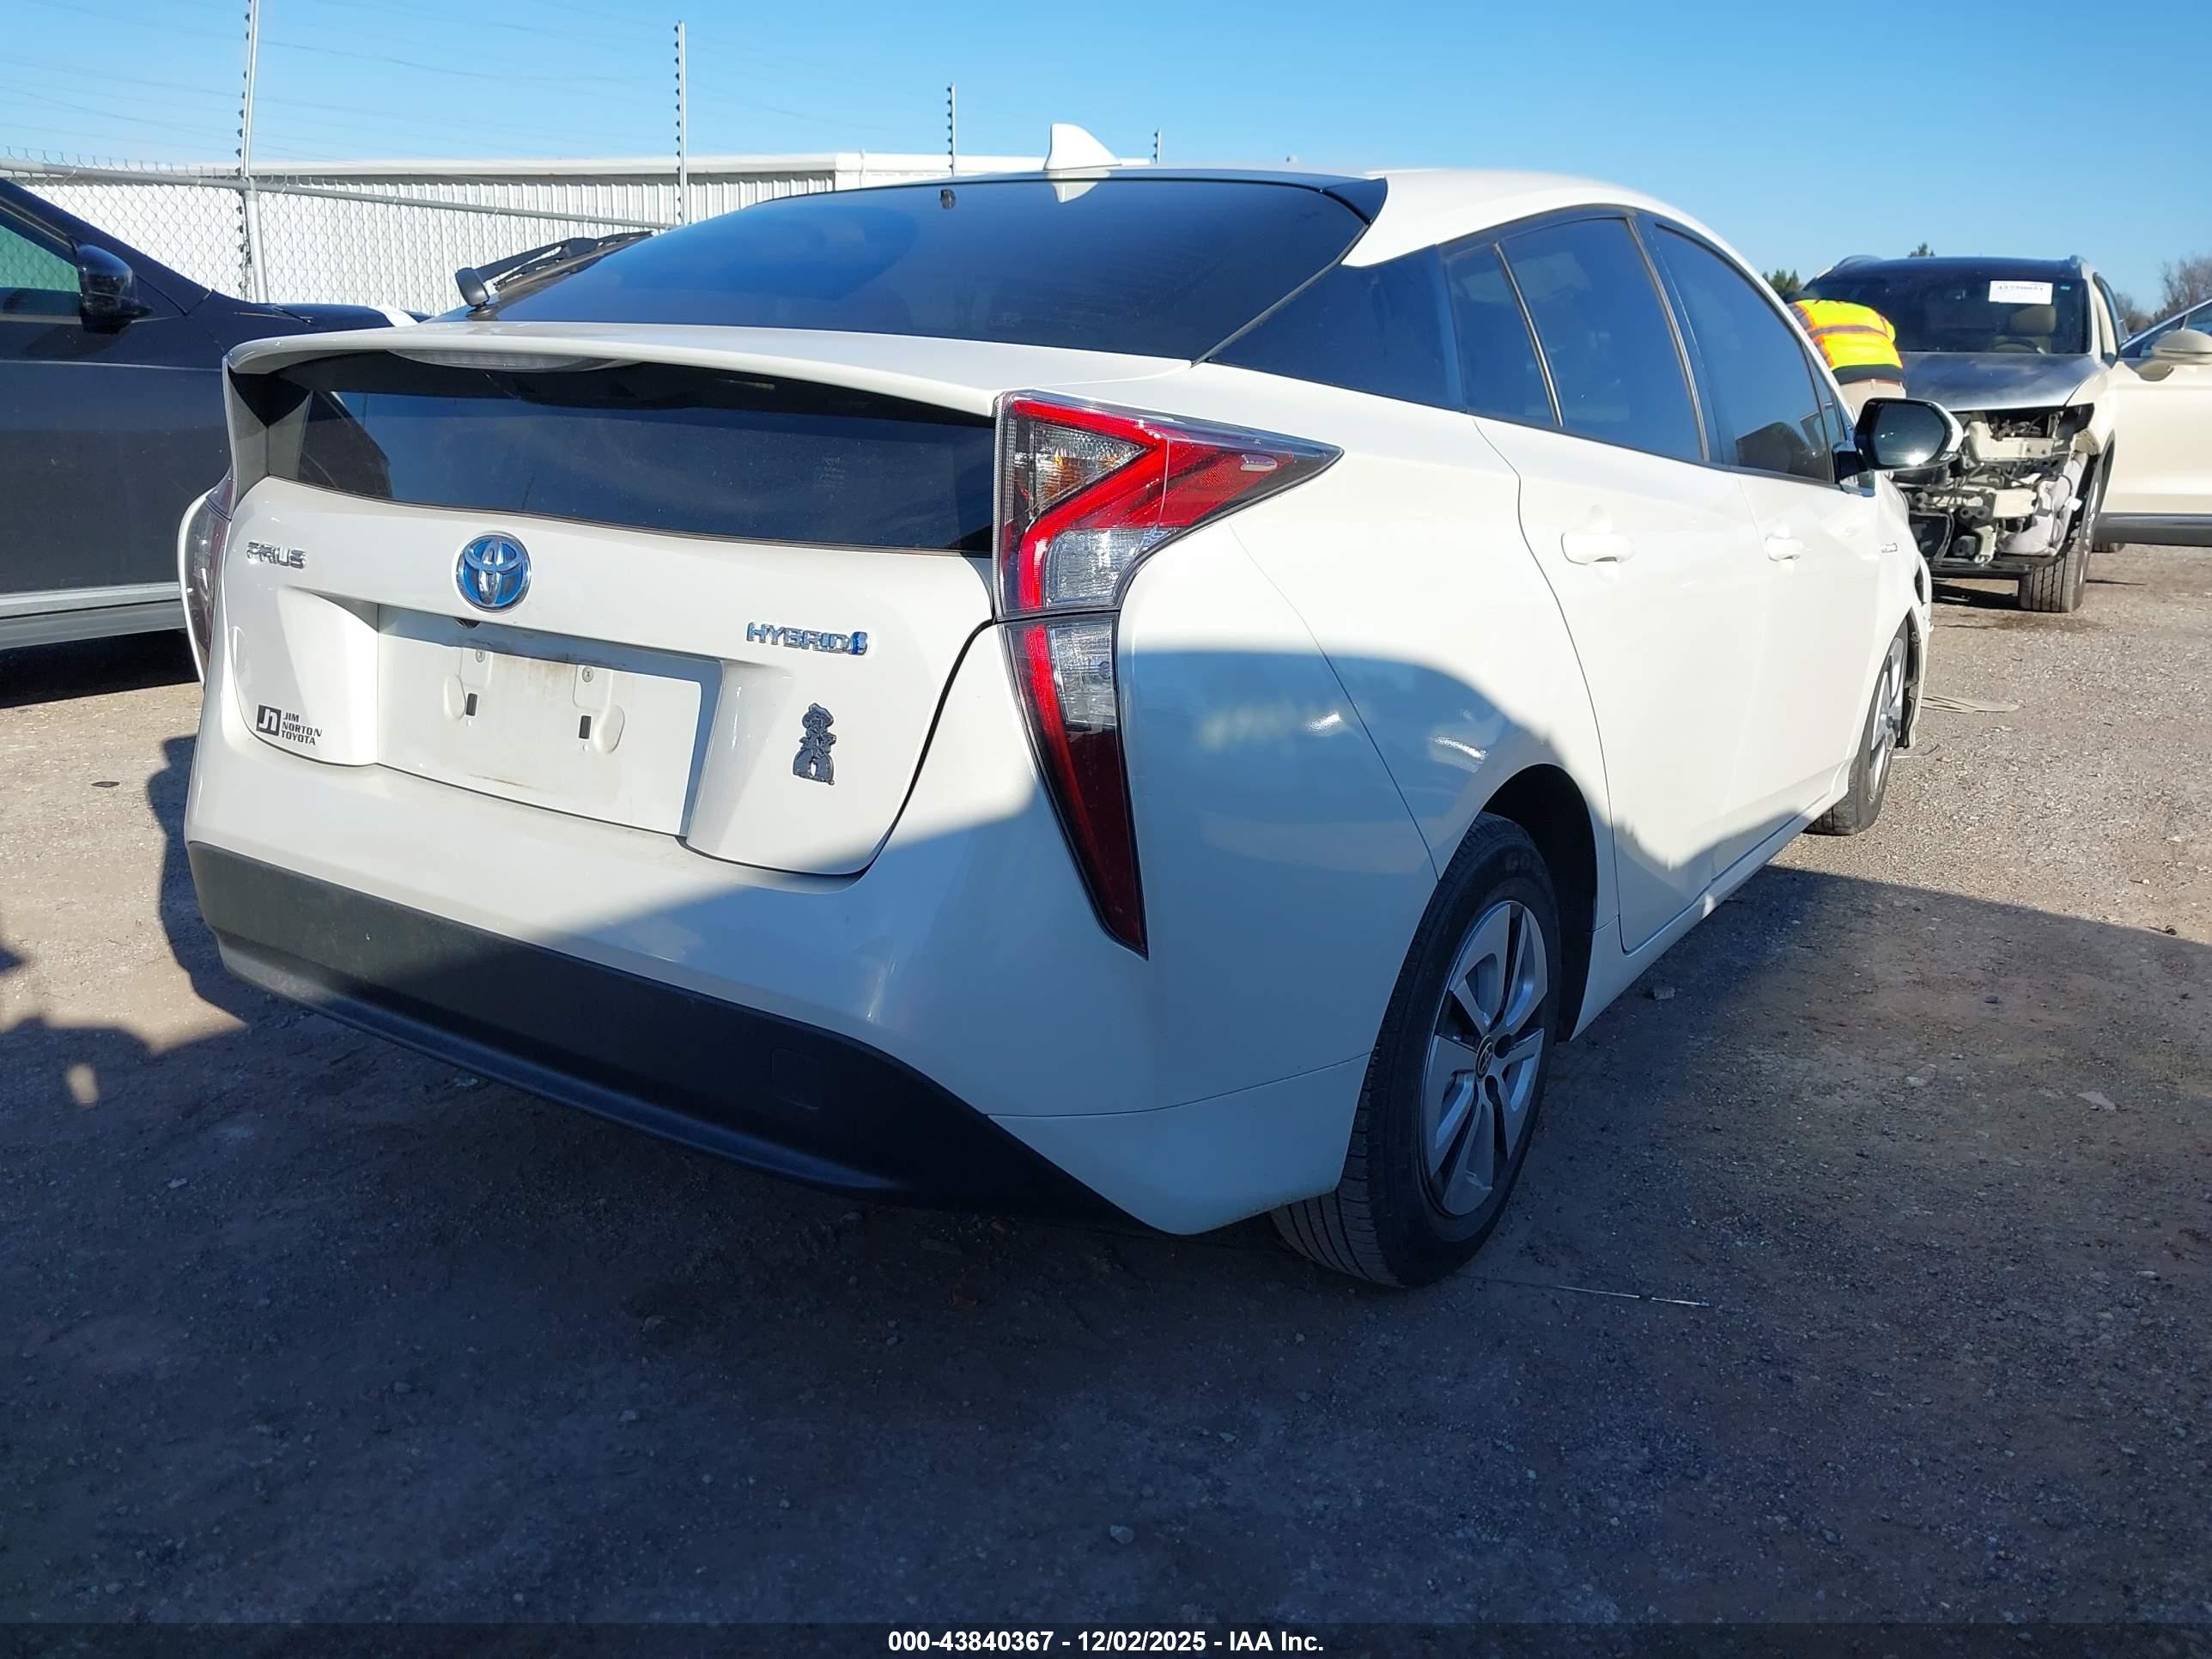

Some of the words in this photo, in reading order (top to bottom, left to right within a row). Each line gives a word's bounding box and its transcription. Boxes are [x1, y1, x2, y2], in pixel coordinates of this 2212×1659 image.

[246, 541, 307, 569] PRIUS
[746, 622, 852, 654] HYBRID
[283, 712, 300, 723] JIM
[282, 721, 323, 737] NORTON
[281, 730, 316, 745] TOYOTA
